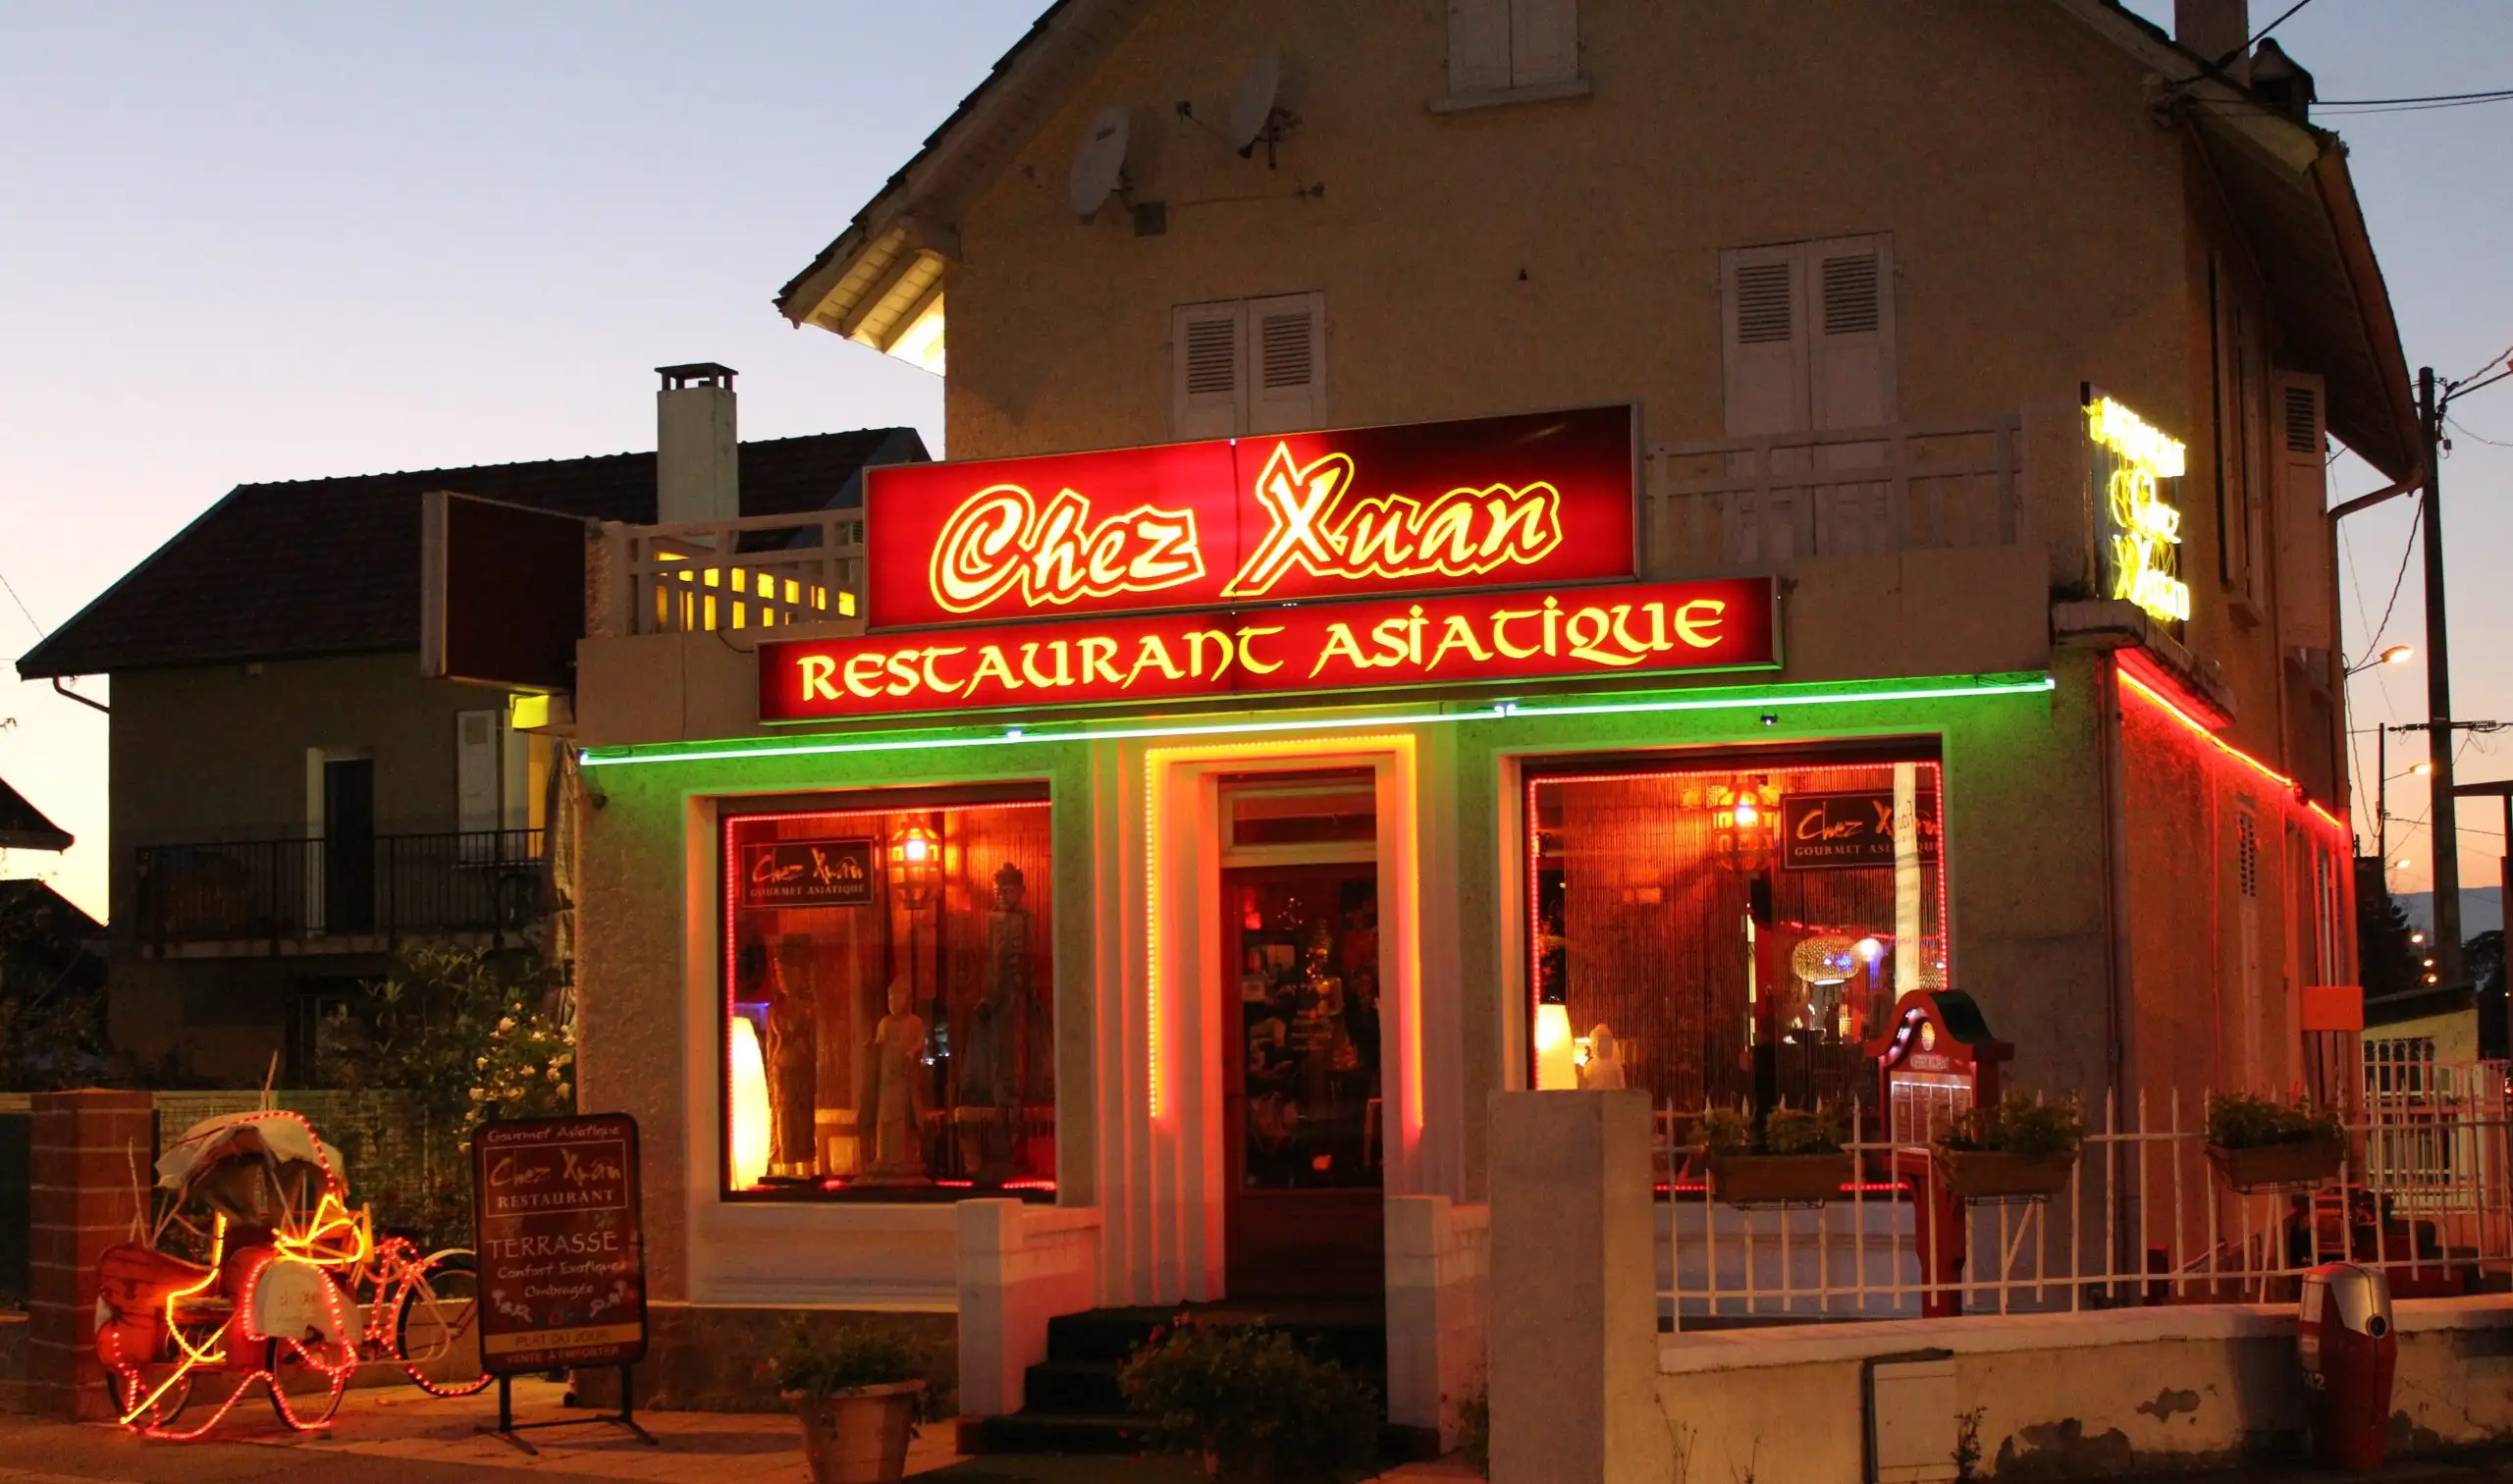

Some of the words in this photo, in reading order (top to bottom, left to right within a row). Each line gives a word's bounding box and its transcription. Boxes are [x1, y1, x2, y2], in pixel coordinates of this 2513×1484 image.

[930, 484, 1205, 613] Chez
[1220, 441, 1563, 597] Xuan
[796, 626, 1285, 701] RESTAURANT
[1796, 800, 1863, 841] Chez
[1794, 843, 1862, 857] GOURMET
[1869, 841, 1940, 855] ASIQU
[752, 847, 804, 883] Chez
[750, 886, 802, 898] GOURMET
[806, 884, 865, 895] ASIATIQUE
[487, 1127, 553, 1142] Gourmet
[557, 1124, 620, 1140] Asiatique
[490, 1148, 552, 1188] Chez
[497, 1189, 615, 1209] RESTAURANT
[486, 1231, 619, 1260] TERRASSE
[498, 1263, 554, 1280] Confort
[515, 1335, 546, 1348] PLAT
[552, 1333, 570, 1346] DU
[507, 1351, 543, 1364] VENTE
